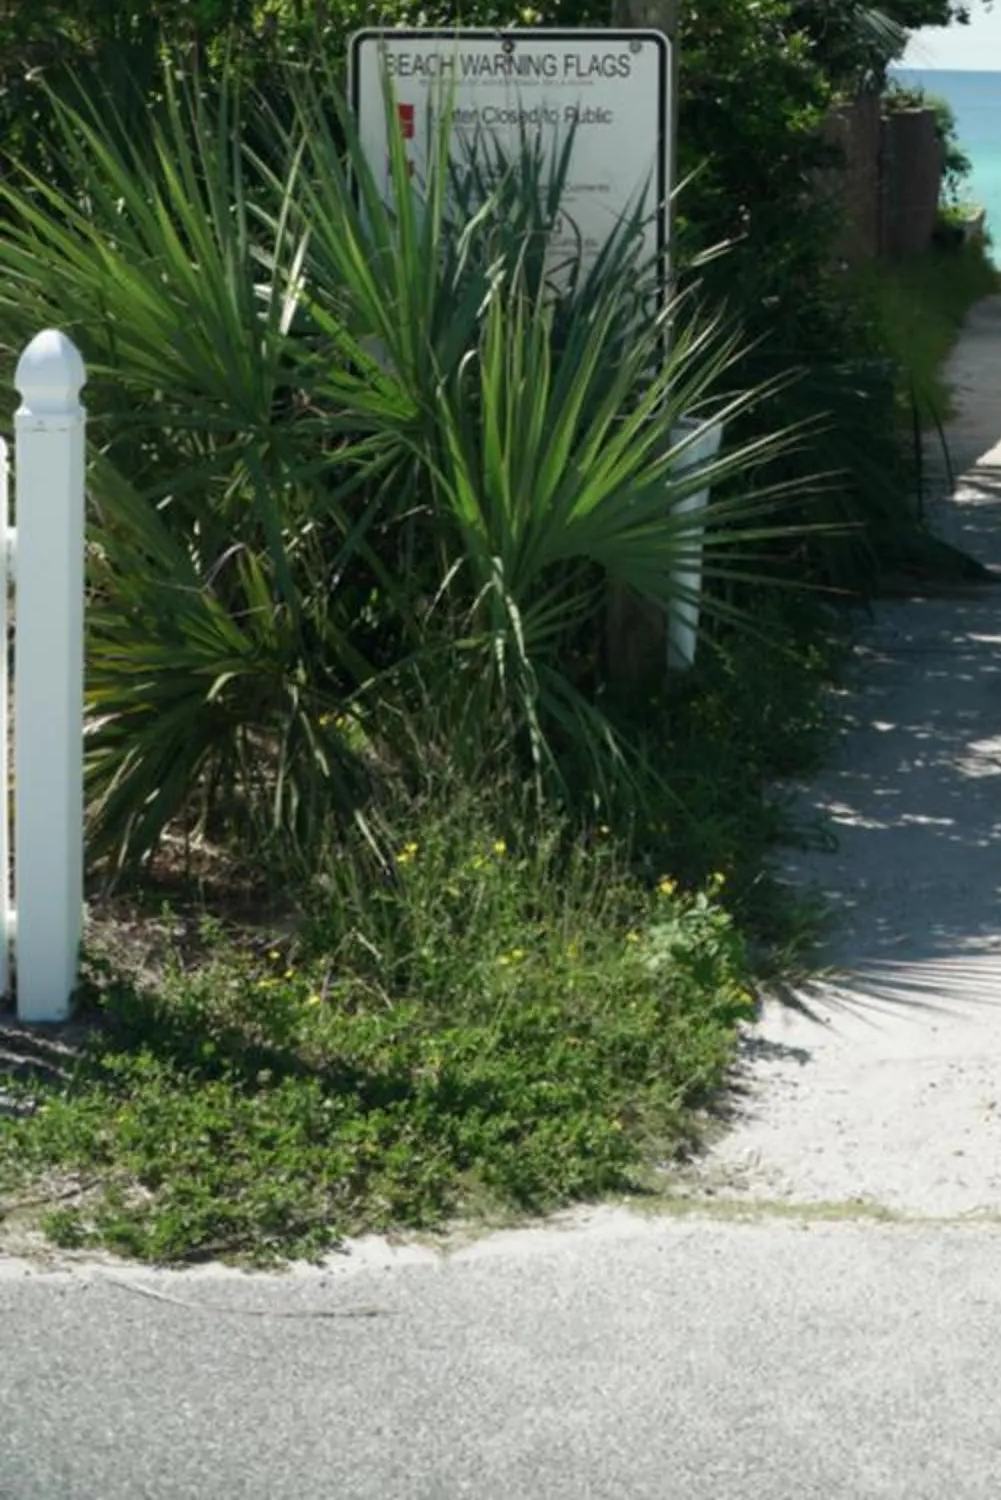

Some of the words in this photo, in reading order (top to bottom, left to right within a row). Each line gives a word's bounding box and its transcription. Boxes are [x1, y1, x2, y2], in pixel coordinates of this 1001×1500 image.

[384, 53, 455, 77] BEACH
[461, 54, 558, 77] WARNING
[563, 54, 632, 78] FLAGS
[482, 105, 538, 124] Closed
[542, 107, 560, 124] to
[563, 105, 614, 124] Public
